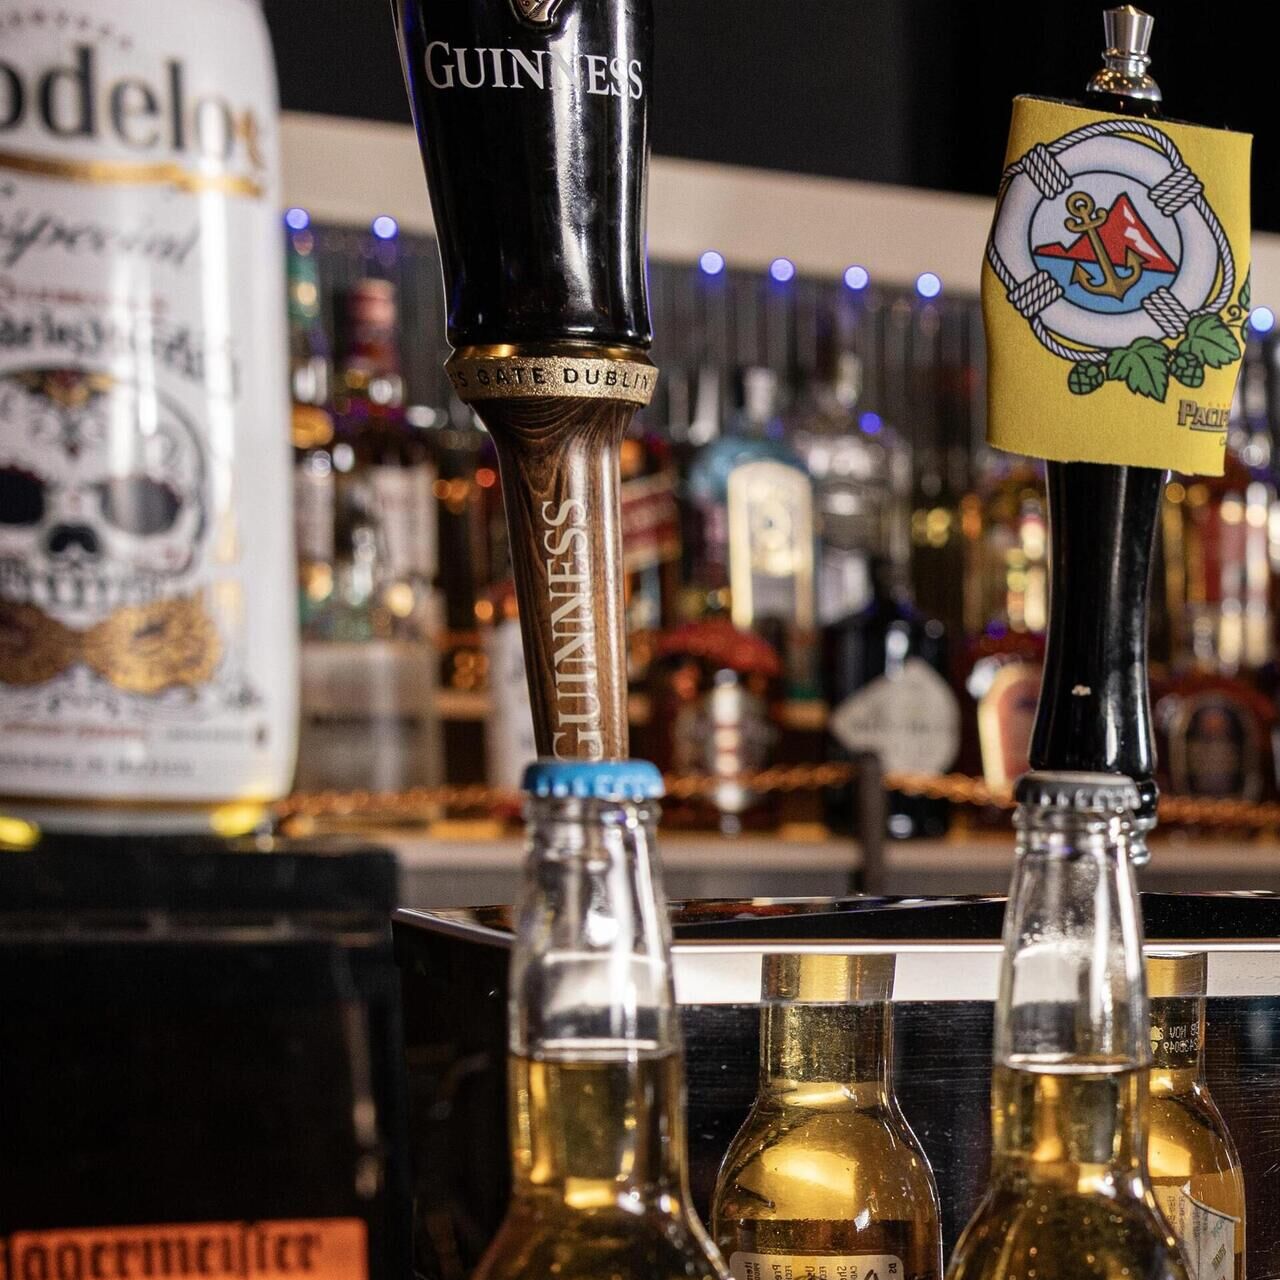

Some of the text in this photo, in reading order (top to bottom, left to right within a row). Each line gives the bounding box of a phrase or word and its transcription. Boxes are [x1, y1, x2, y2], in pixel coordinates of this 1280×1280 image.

[424, 40, 643, 100] GUINNESS
[477, 367, 547, 386] GATE
[563, 367, 650, 391] DUBLIN
[541, 498, 605, 762] GUINNESS
